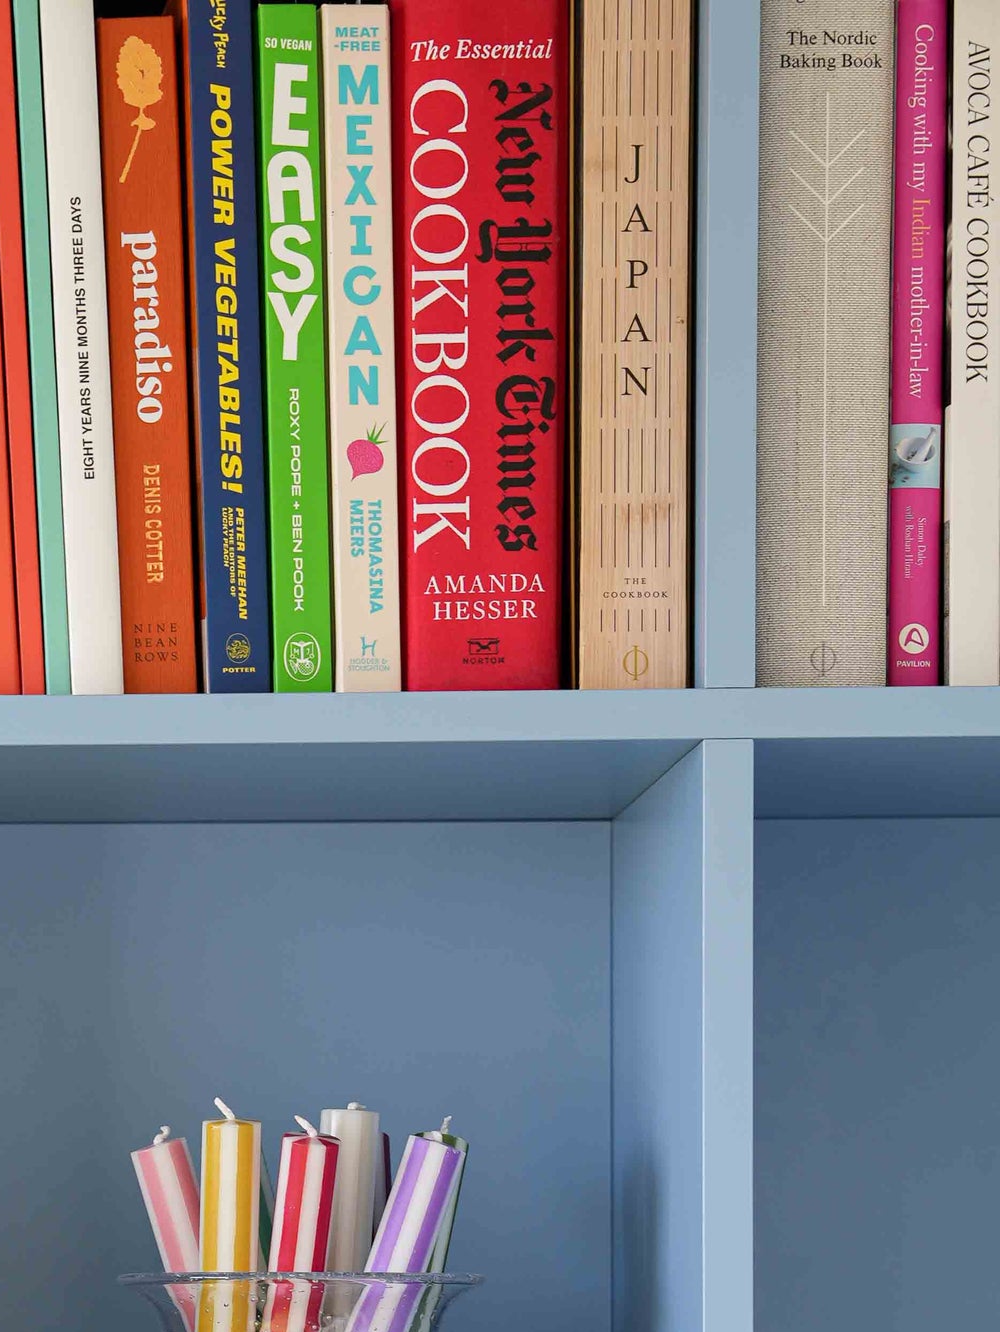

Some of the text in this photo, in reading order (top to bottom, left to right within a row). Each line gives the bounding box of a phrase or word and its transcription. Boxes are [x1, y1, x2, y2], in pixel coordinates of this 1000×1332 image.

[265, 37, 312, 51] SO VEGAN
[334, 41, 381, 52] -FREE
[335, 26, 379, 38] MEAT
[410, 38, 553, 62] The Essential
[786, 30, 877, 46] The Nordic
[780, 53, 882, 71] Baking Book
[267, 63, 318, 361] EASY
[337, 64, 382, 406] MEXICAN
[906, 24, 935, 399] Cooking with my Indian mother-in-law
[965, 41, 994, 383] AVOCA CAFÉ COOKBOOK
[209, 83, 244, 494] POWER VEGETABLES!
[620, 144, 653, 397] JAPAN
[70, 196, 95, 480] EIGHT YEARS NINE MONTHS THREE DAYS
[120, 230, 173, 424] paradiso
[410, 78, 471, 554] COOKBOOK
[474, 79, 557, 551] New York Times
[143, 463, 164, 584] DENIS COTTER
[288, 388, 305, 612] ROXY POPE + BEN POOK
[349, 499, 365, 558] MIERS
[221, 507, 230, 567] LUCKY PEACH
[235, 507, 248, 620] PETER MEEHAN
[367, 499, 384, 614] THOMASINA
[904, 506, 914, 580] with Roshan Hirani
[915, 517, 927, 567] Simon Daley
[230, 585, 236, 597] OF
[424, 573, 546, 595] AMANDA
[432, 600, 538, 621] HESSER
[603, 590, 669, 599] COOKBOOK
[624, 577, 647, 585] THE
[133, 622, 178, 633] NINE
[134, 636, 178, 648] BEAN
[134, 651, 179, 662] ROWS
[896, 660, 931, 668] PAVILION
